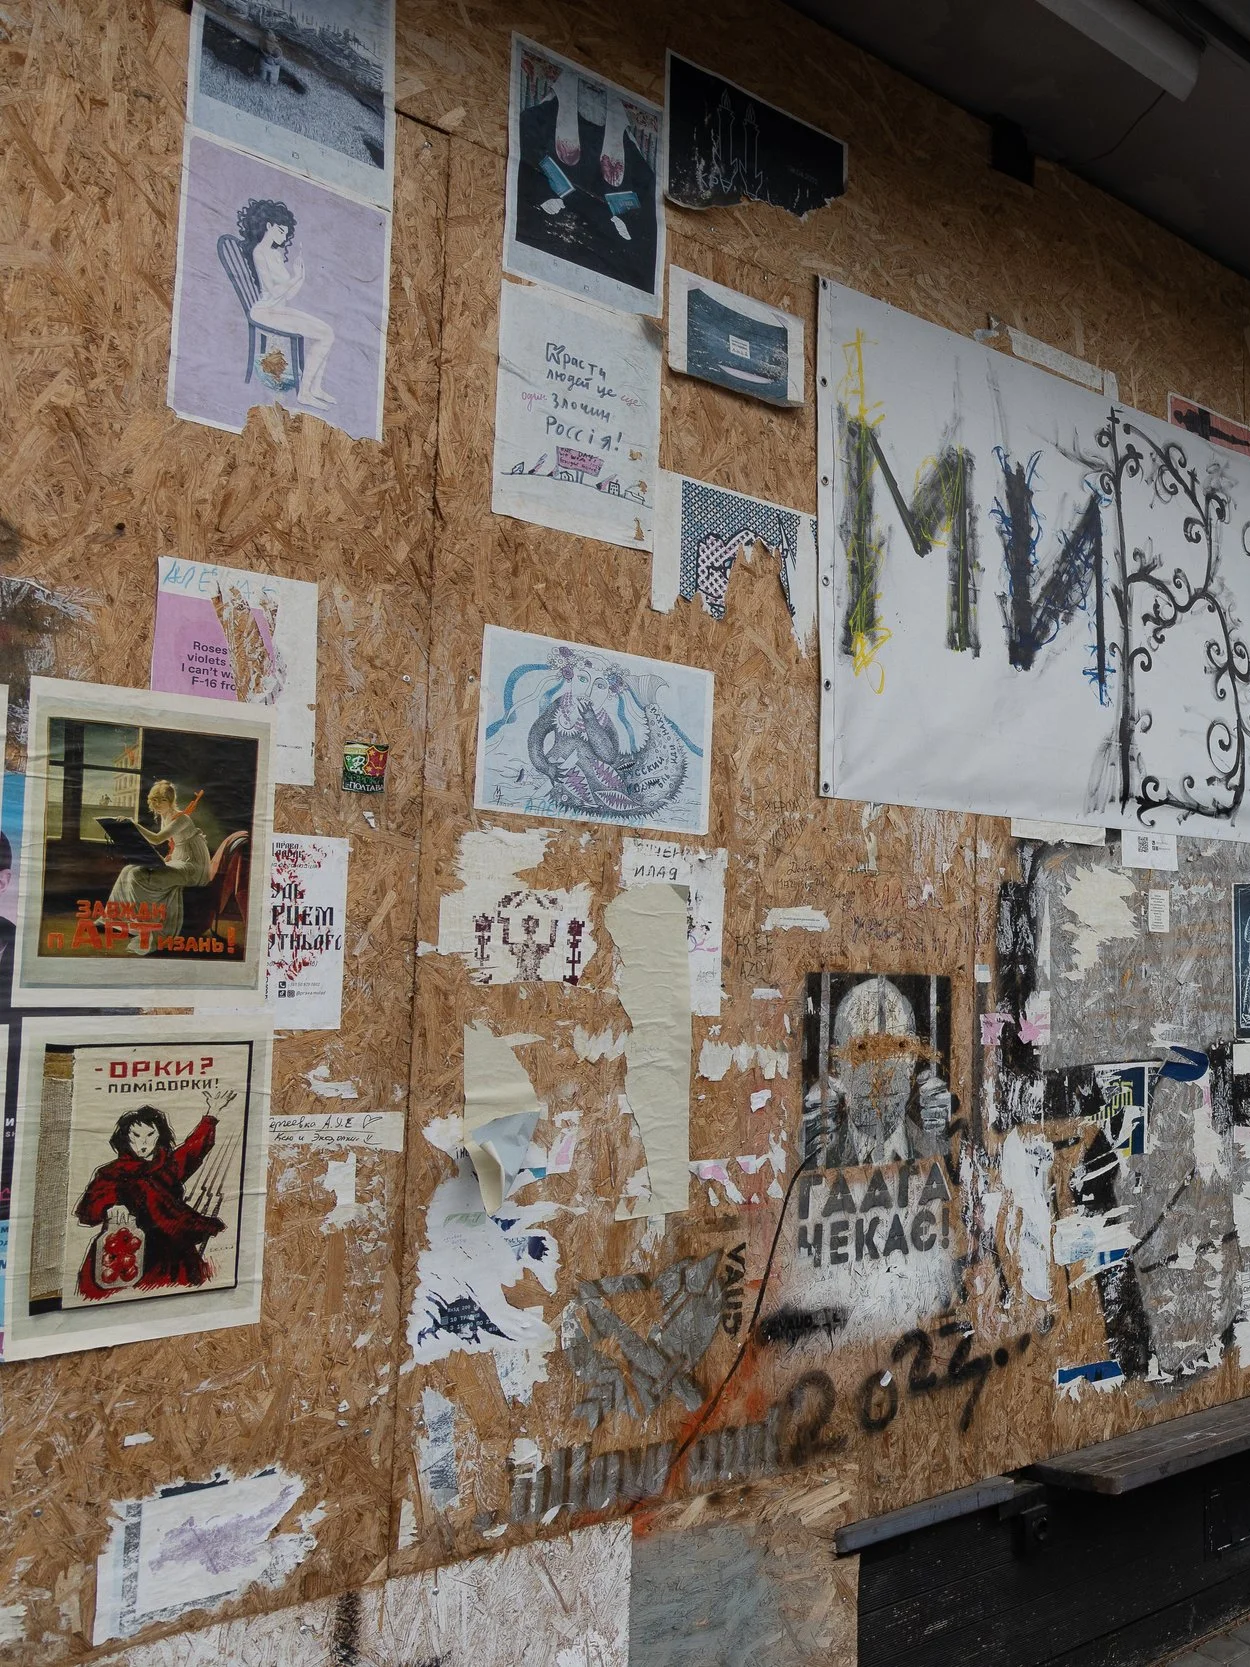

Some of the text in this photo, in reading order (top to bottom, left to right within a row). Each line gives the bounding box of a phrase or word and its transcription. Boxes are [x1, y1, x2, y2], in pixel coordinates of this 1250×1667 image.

[193, 640, 228, 655] Roses
[187, 653, 226, 667] violets
[181, 663, 185, 672] I
[188, 666, 218, 677] can't
[191, 676, 217, 689] F-16
[76, 900, 168, 920] ЗАВЖДИ
[798, 1162, 952, 1220] ГААГА
[798, 1207, 950, 1268] ЧЕКАЄ!
